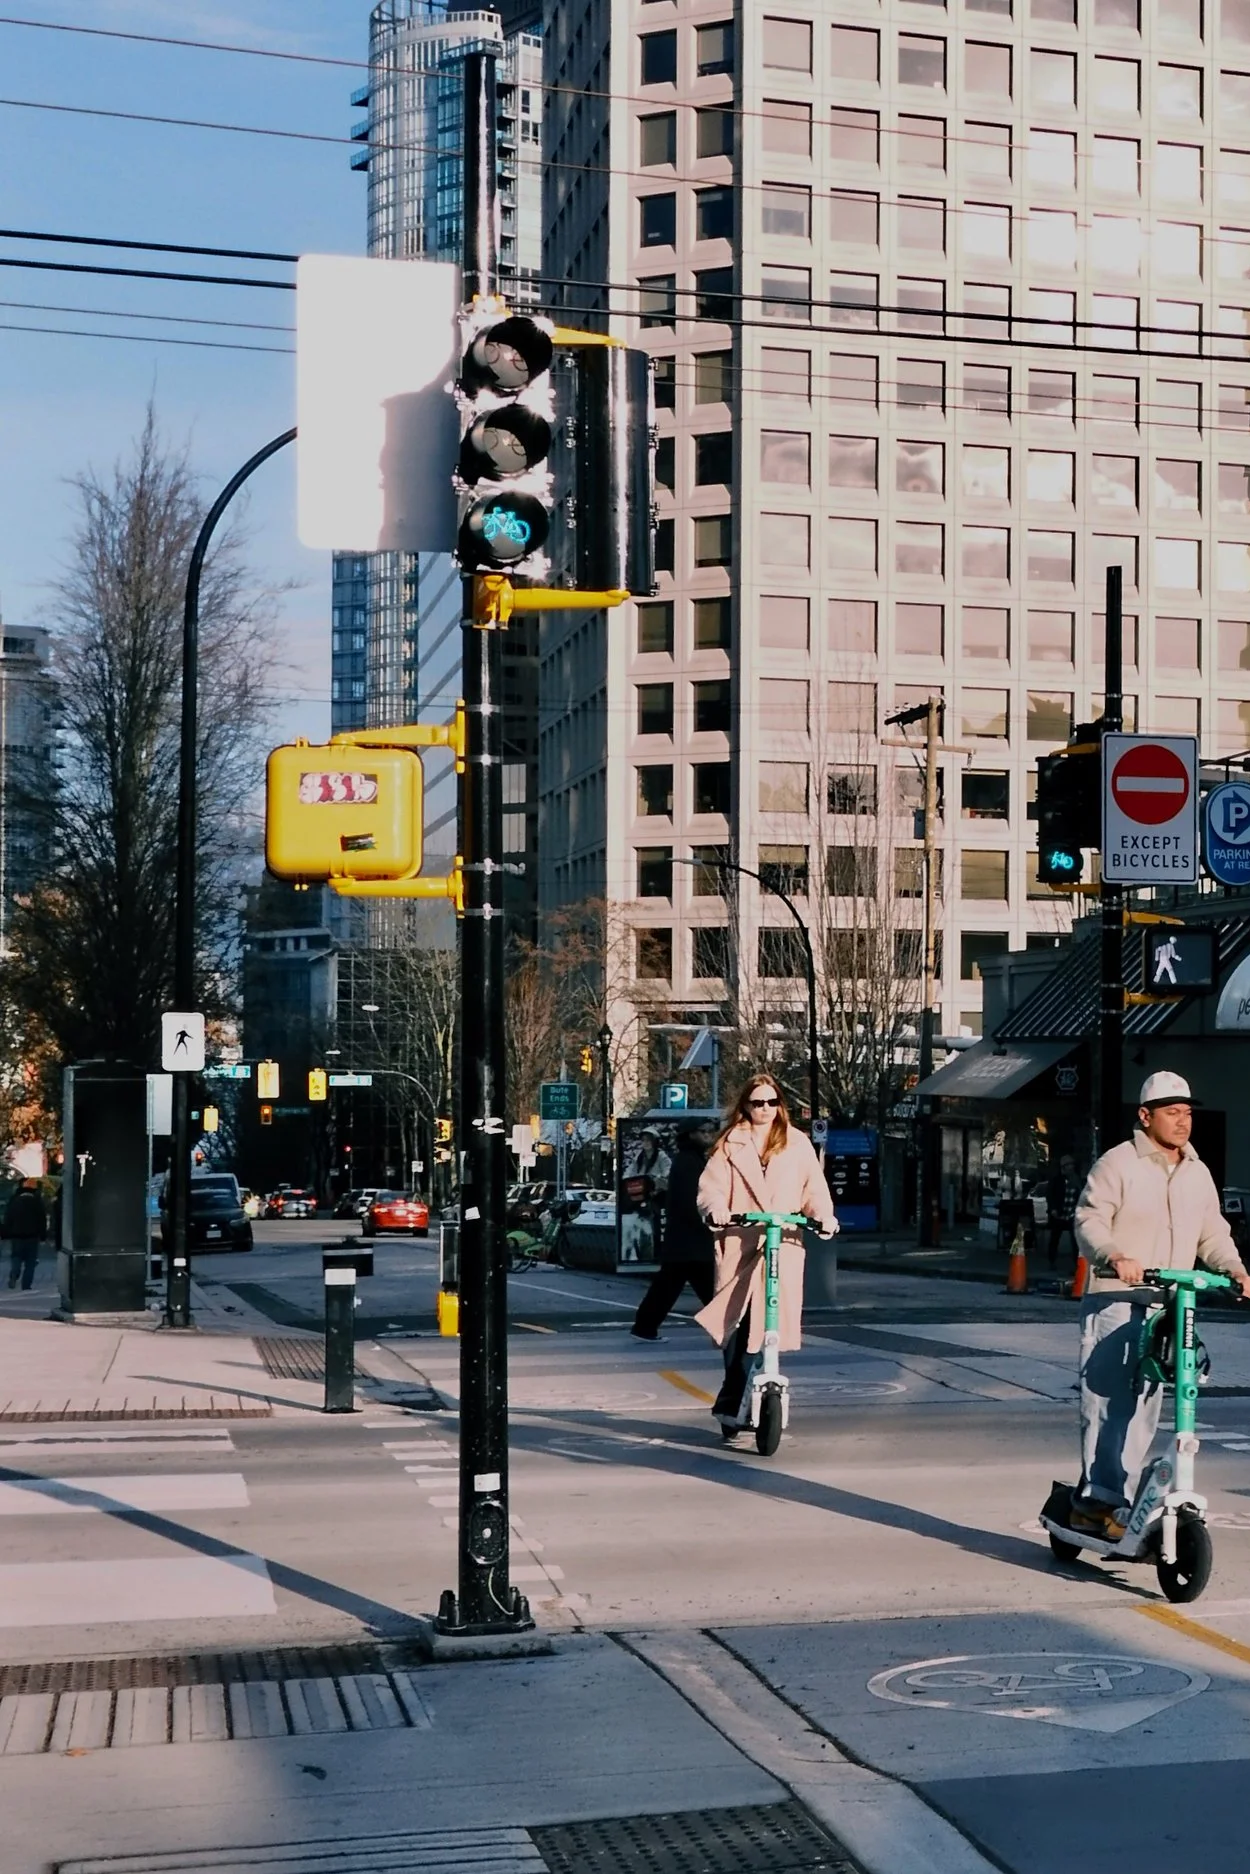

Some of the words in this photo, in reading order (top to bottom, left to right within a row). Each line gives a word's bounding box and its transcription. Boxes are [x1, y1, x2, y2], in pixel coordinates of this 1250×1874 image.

[1229, 802, 1249, 827] P
[1121, 835, 1181, 849] EXCEPT
[1112, 854, 1189, 868] BICYCLES
[1224, 861, 1235, 869] AT
[666, 1087, 684, 1108] P
